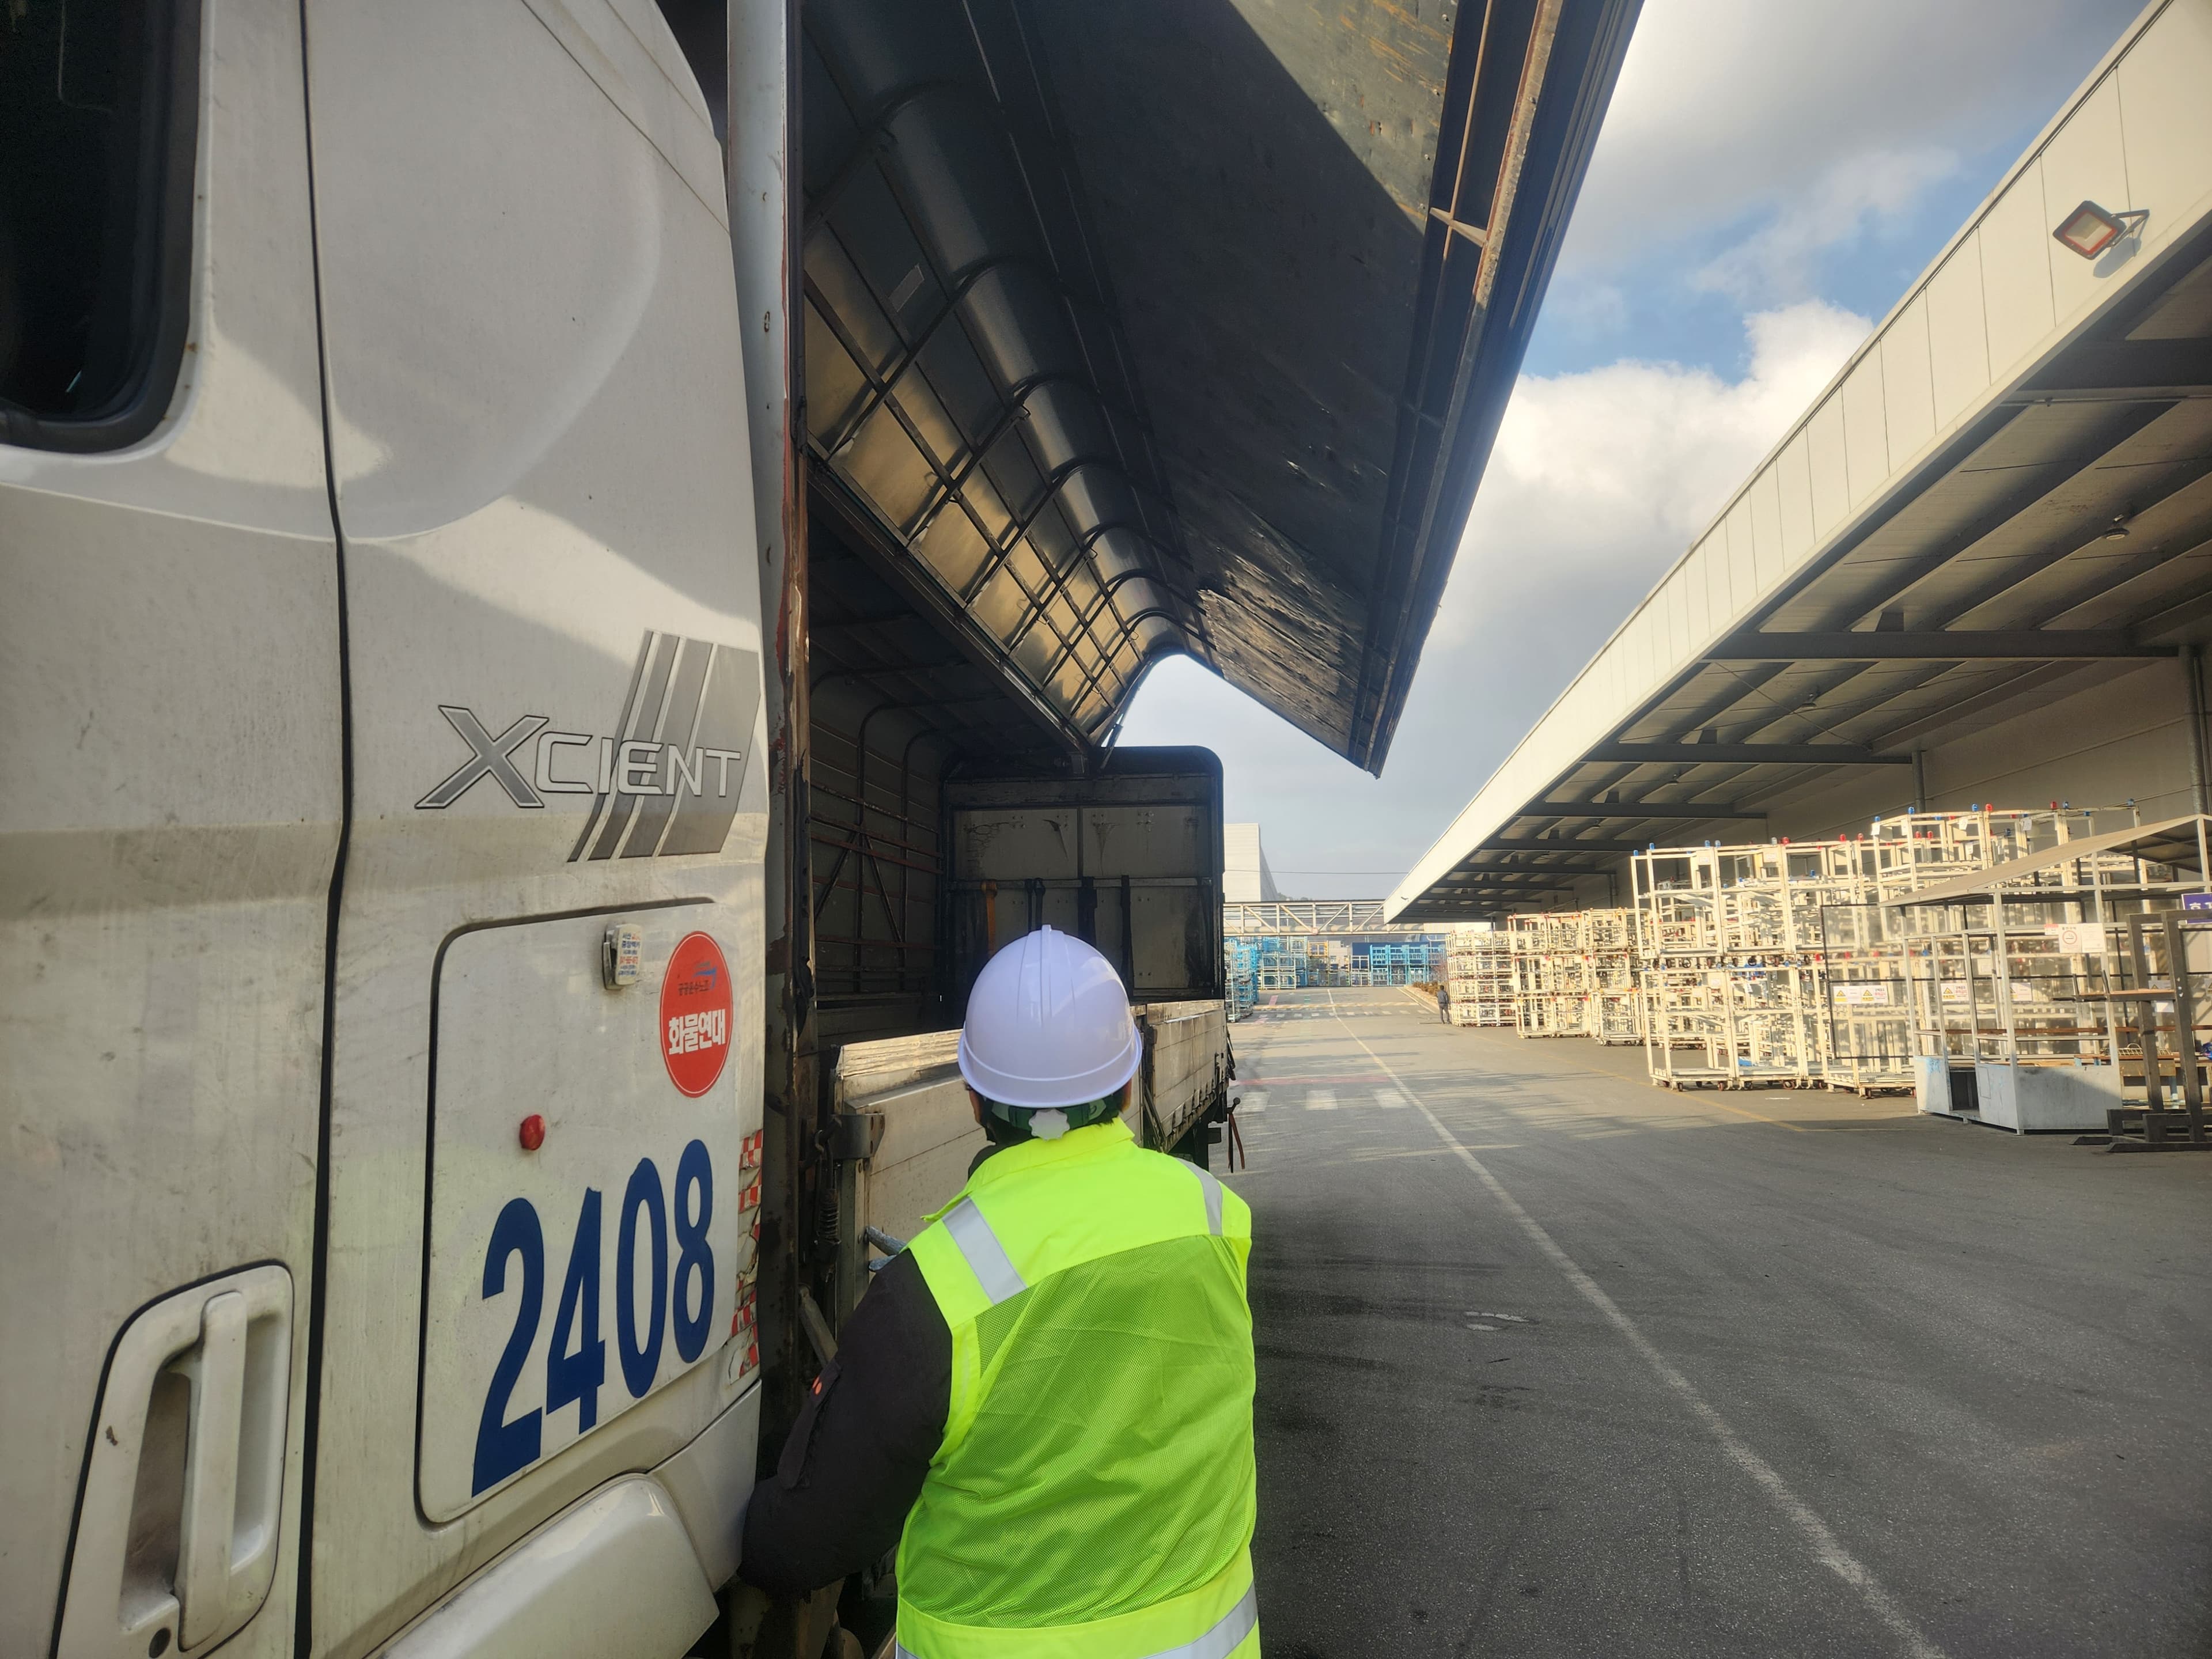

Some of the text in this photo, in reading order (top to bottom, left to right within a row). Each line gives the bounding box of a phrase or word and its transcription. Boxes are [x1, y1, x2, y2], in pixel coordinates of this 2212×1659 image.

[414, 704, 741, 809] XCIENT
[669, 1009, 726, 1055] 화물연대
[471, 1139, 714, 1497] 2408
